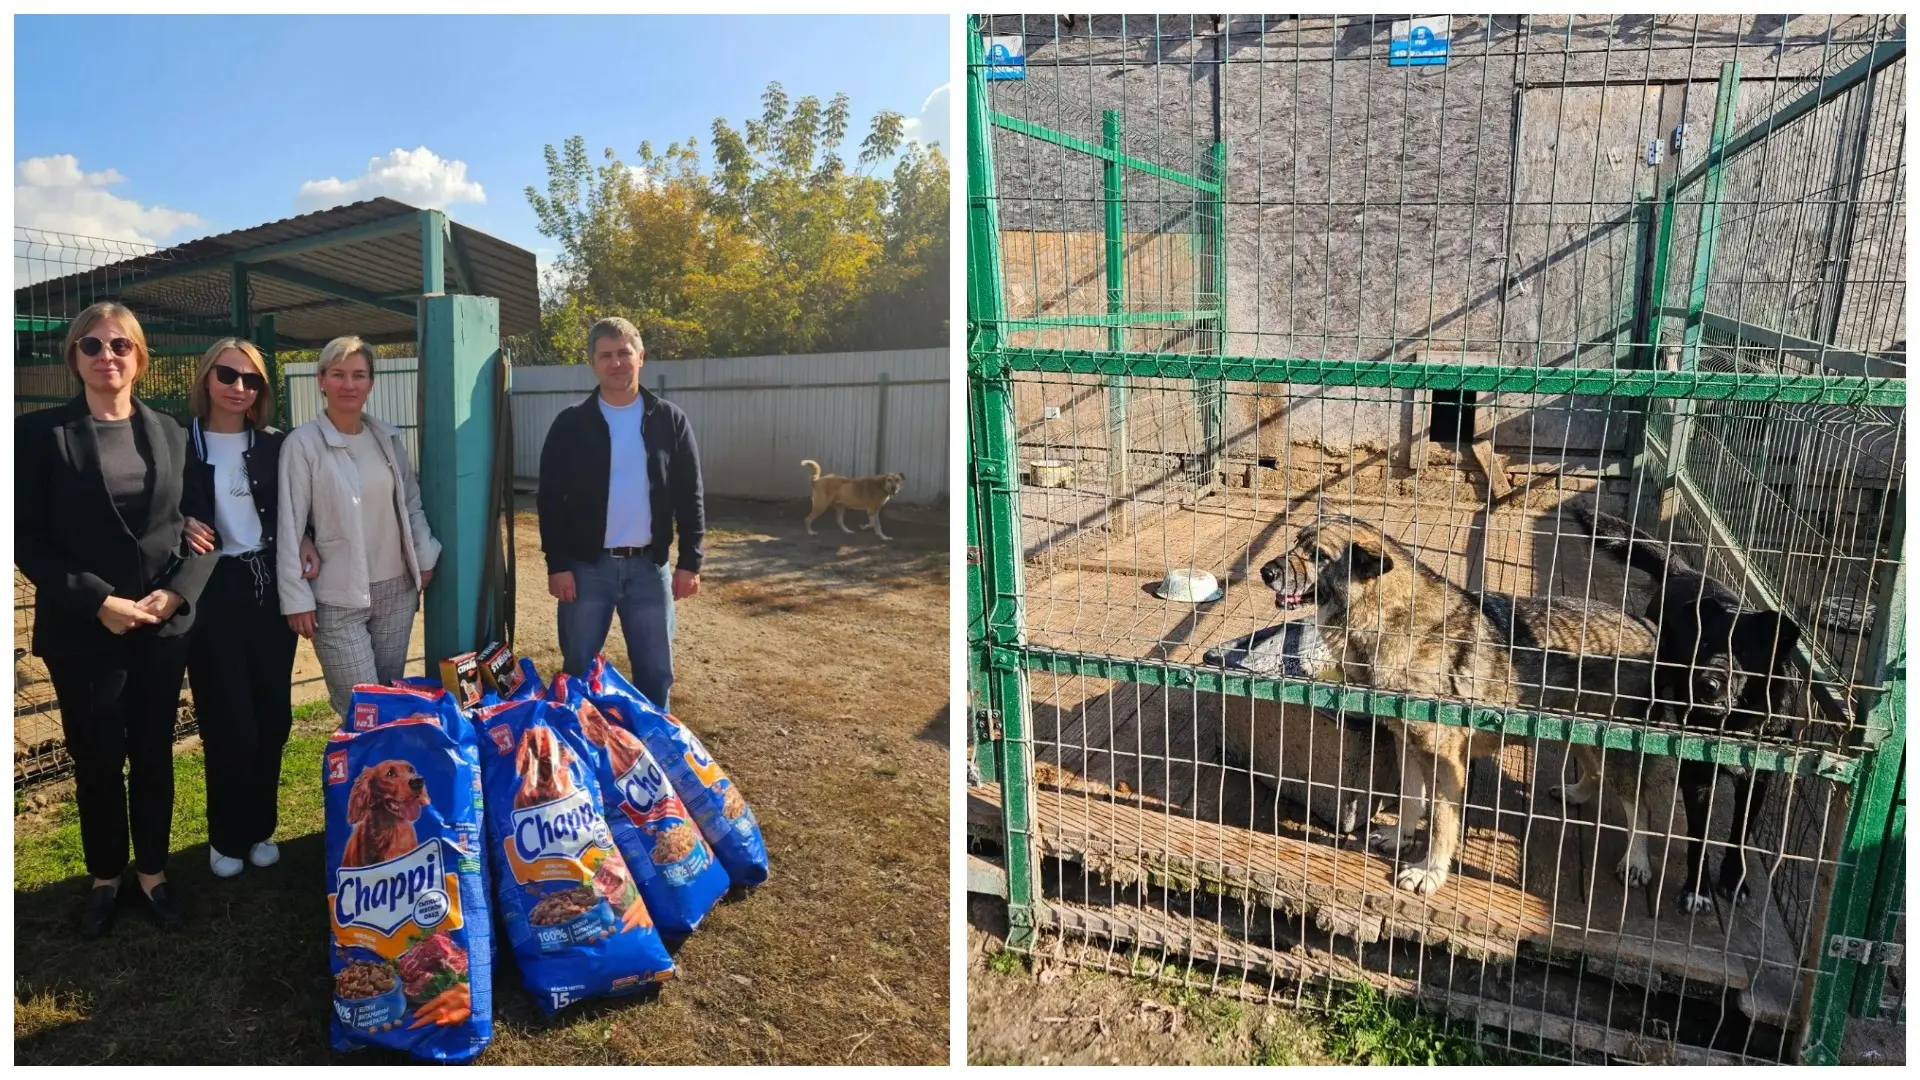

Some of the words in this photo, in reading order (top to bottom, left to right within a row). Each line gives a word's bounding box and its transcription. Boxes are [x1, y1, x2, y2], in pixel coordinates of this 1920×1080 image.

[1417, 28, 1426, 39] 5
[994, 46, 1003, 56] 5
[490, 648, 512, 673] STRIDE
[335, 854, 436, 922] Chappi
[537, 928, 568, 943] 100%
[550, 991, 570, 1010] 15
